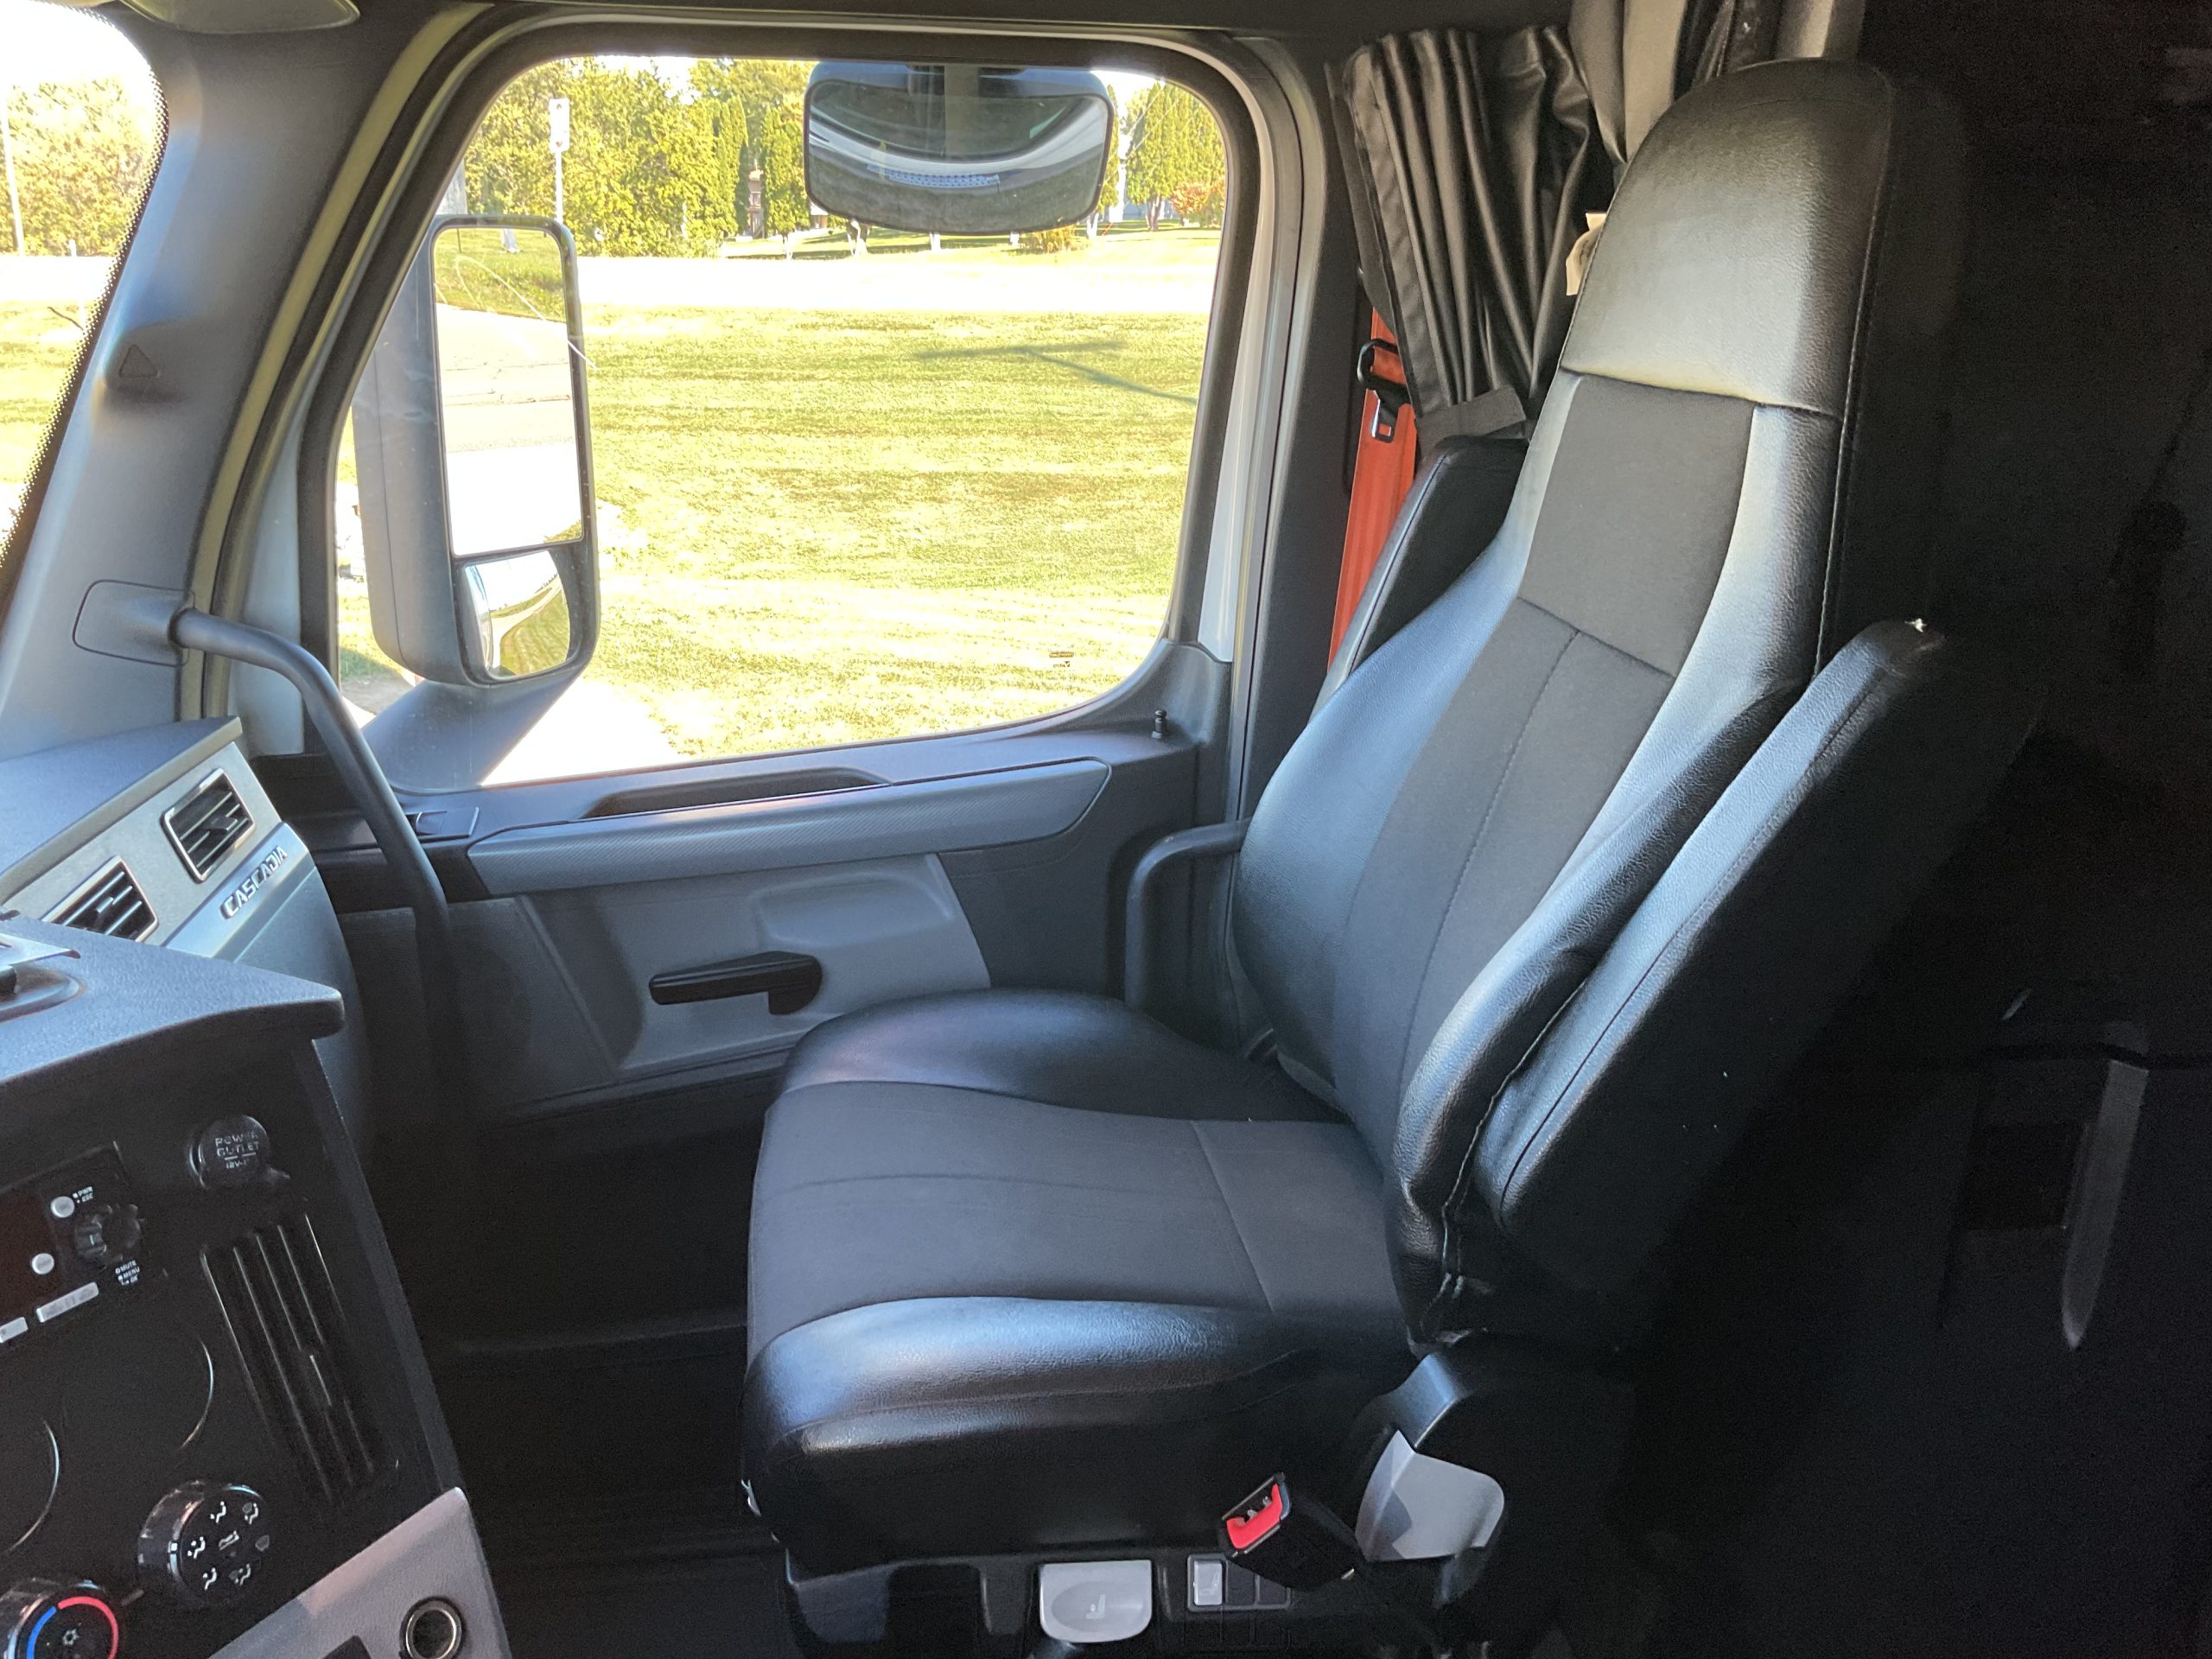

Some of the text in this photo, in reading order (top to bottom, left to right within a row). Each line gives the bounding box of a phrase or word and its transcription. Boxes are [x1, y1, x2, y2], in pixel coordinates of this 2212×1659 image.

[220, 846, 288, 919] CASCADIA
[215, 1133, 258, 1147] POWR
[217, 1141, 259, 1156] OUTLET
[120, 1260, 137, 1272] MUTE
[123, 1267, 140, 1279] MENU
